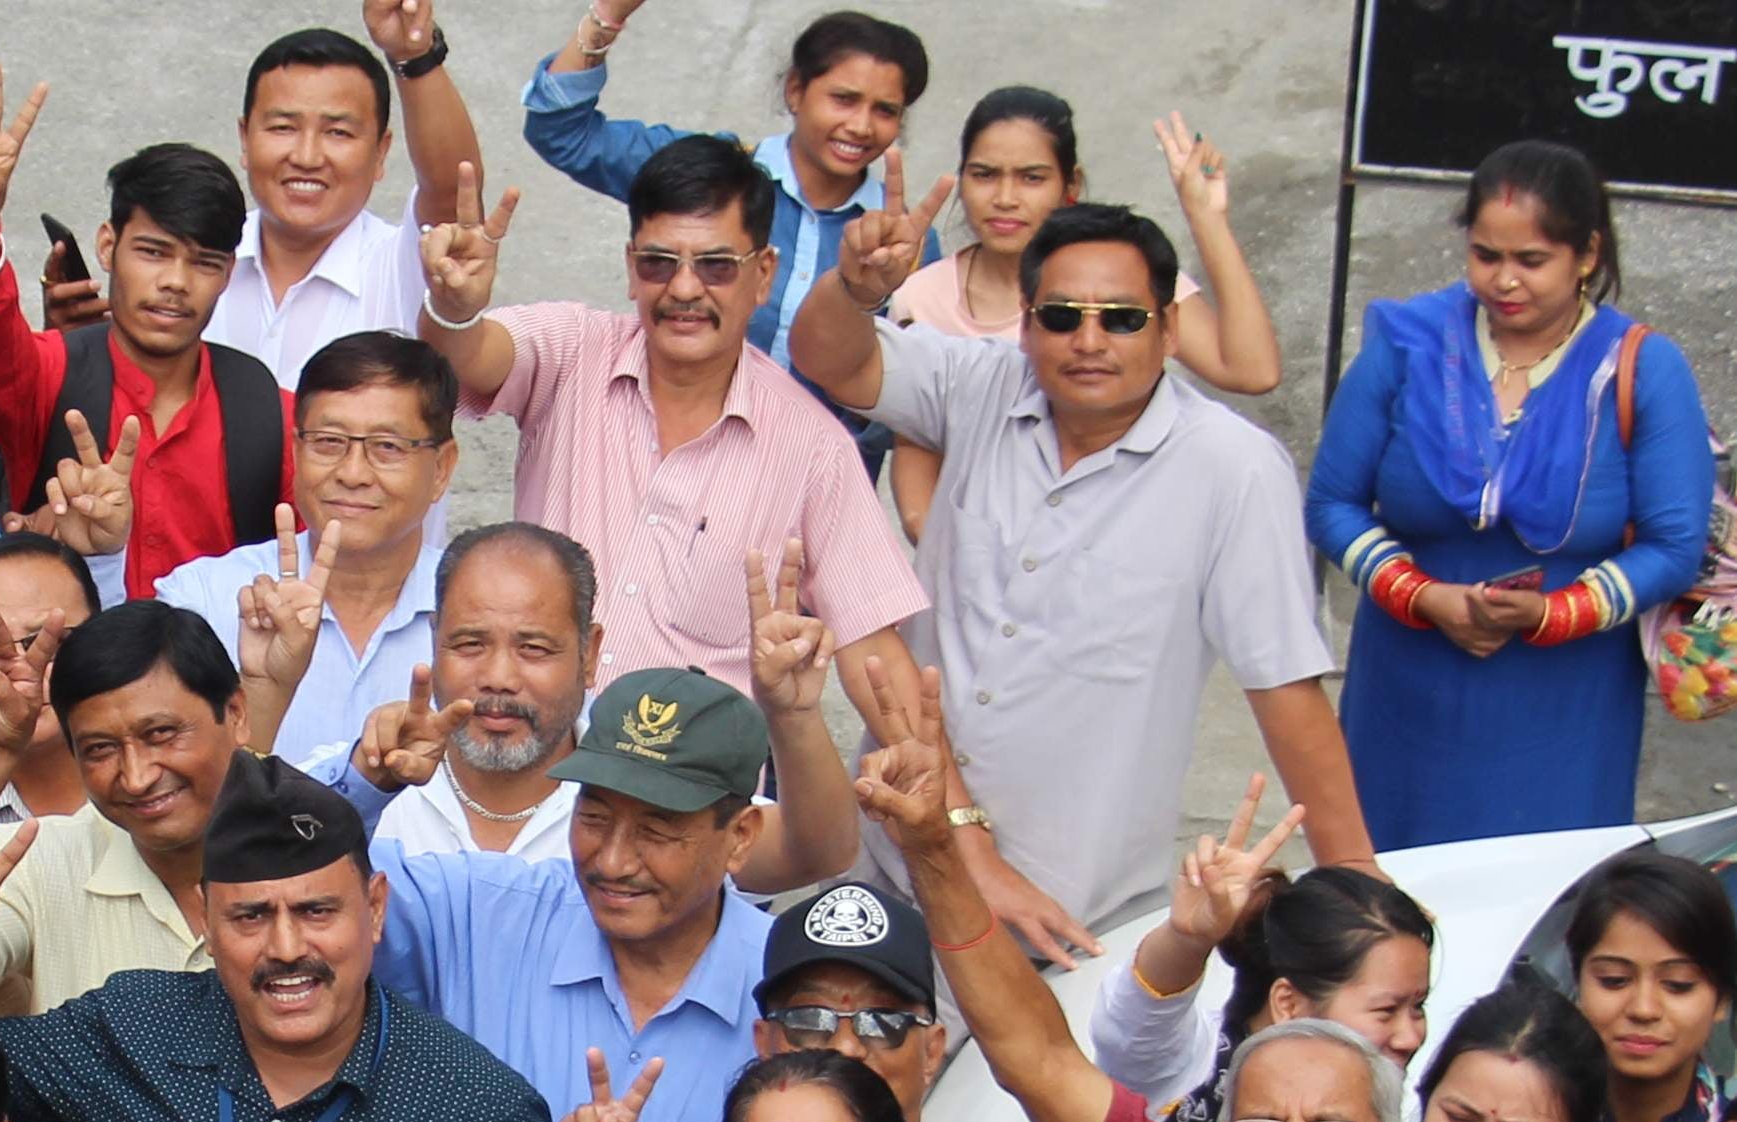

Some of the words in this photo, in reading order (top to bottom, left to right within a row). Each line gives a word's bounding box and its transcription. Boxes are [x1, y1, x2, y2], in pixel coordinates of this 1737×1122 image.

[1552, 34, 1737, 118] फुल
[810, 889, 883, 926] MASTERMIND
[819, 929, 868, 943] TAIPEI
